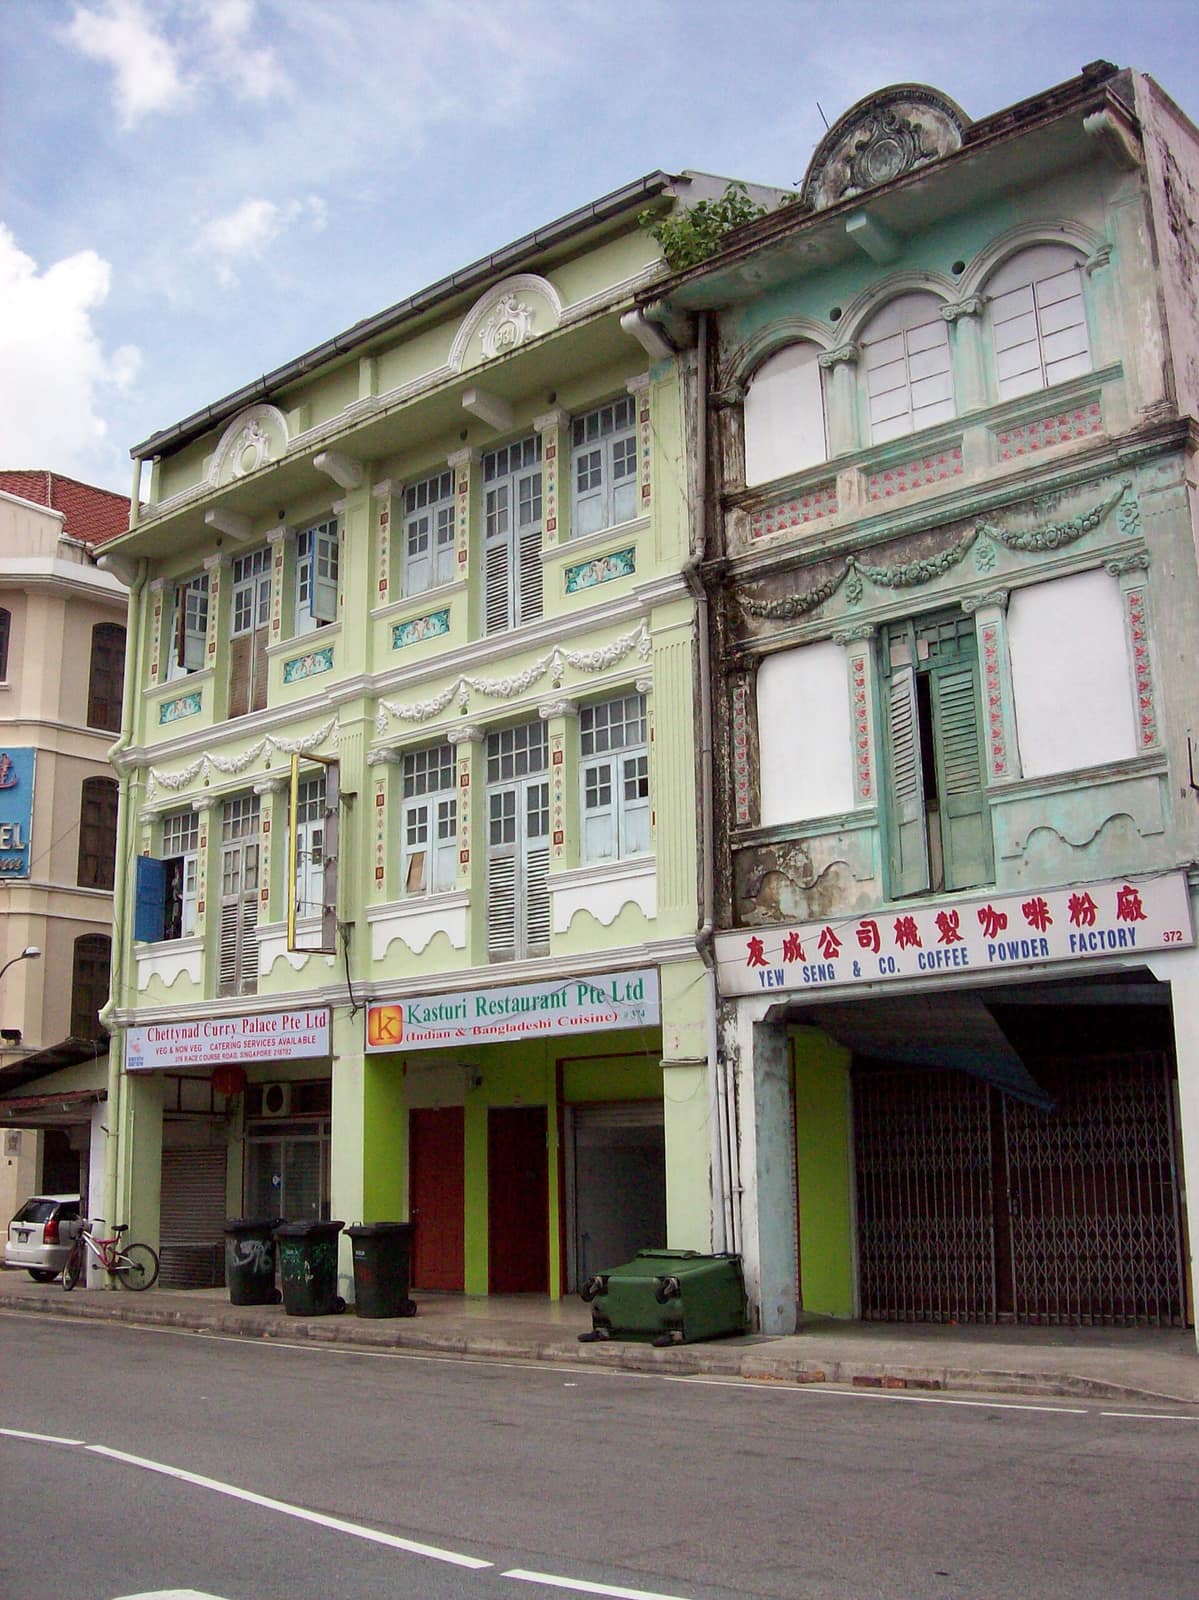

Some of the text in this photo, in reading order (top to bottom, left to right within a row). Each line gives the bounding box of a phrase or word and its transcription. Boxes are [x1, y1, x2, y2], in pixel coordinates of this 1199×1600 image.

[1163, 931, 1183, 943] 372
[759, 927, 1136, 988] YEW SENG & CO. COFFEE POWDER FACTORY
[408, 978, 644, 1024] Kasturi Restaurant Pte Ltd
[203, 1022, 236, 1039] Curry
[242, 1018, 277, 1034] Palace
[282, 1015, 301, 1031] Pte
[306, 1011, 326, 1029] Ltd
[406, 1011, 618, 1042] (Indian & Bangladeshi Cuisine)
[156, 1046, 168, 1055] VEG
[175, 1044, 188, 1053] NON
[190, 1044, 202, 1052] VEG
[210, 1041, 241, 1051] CATERING
[244, 1038, 275, 1048] SERVICES
[279, 1035, 316, 1045] AVAILABLE
